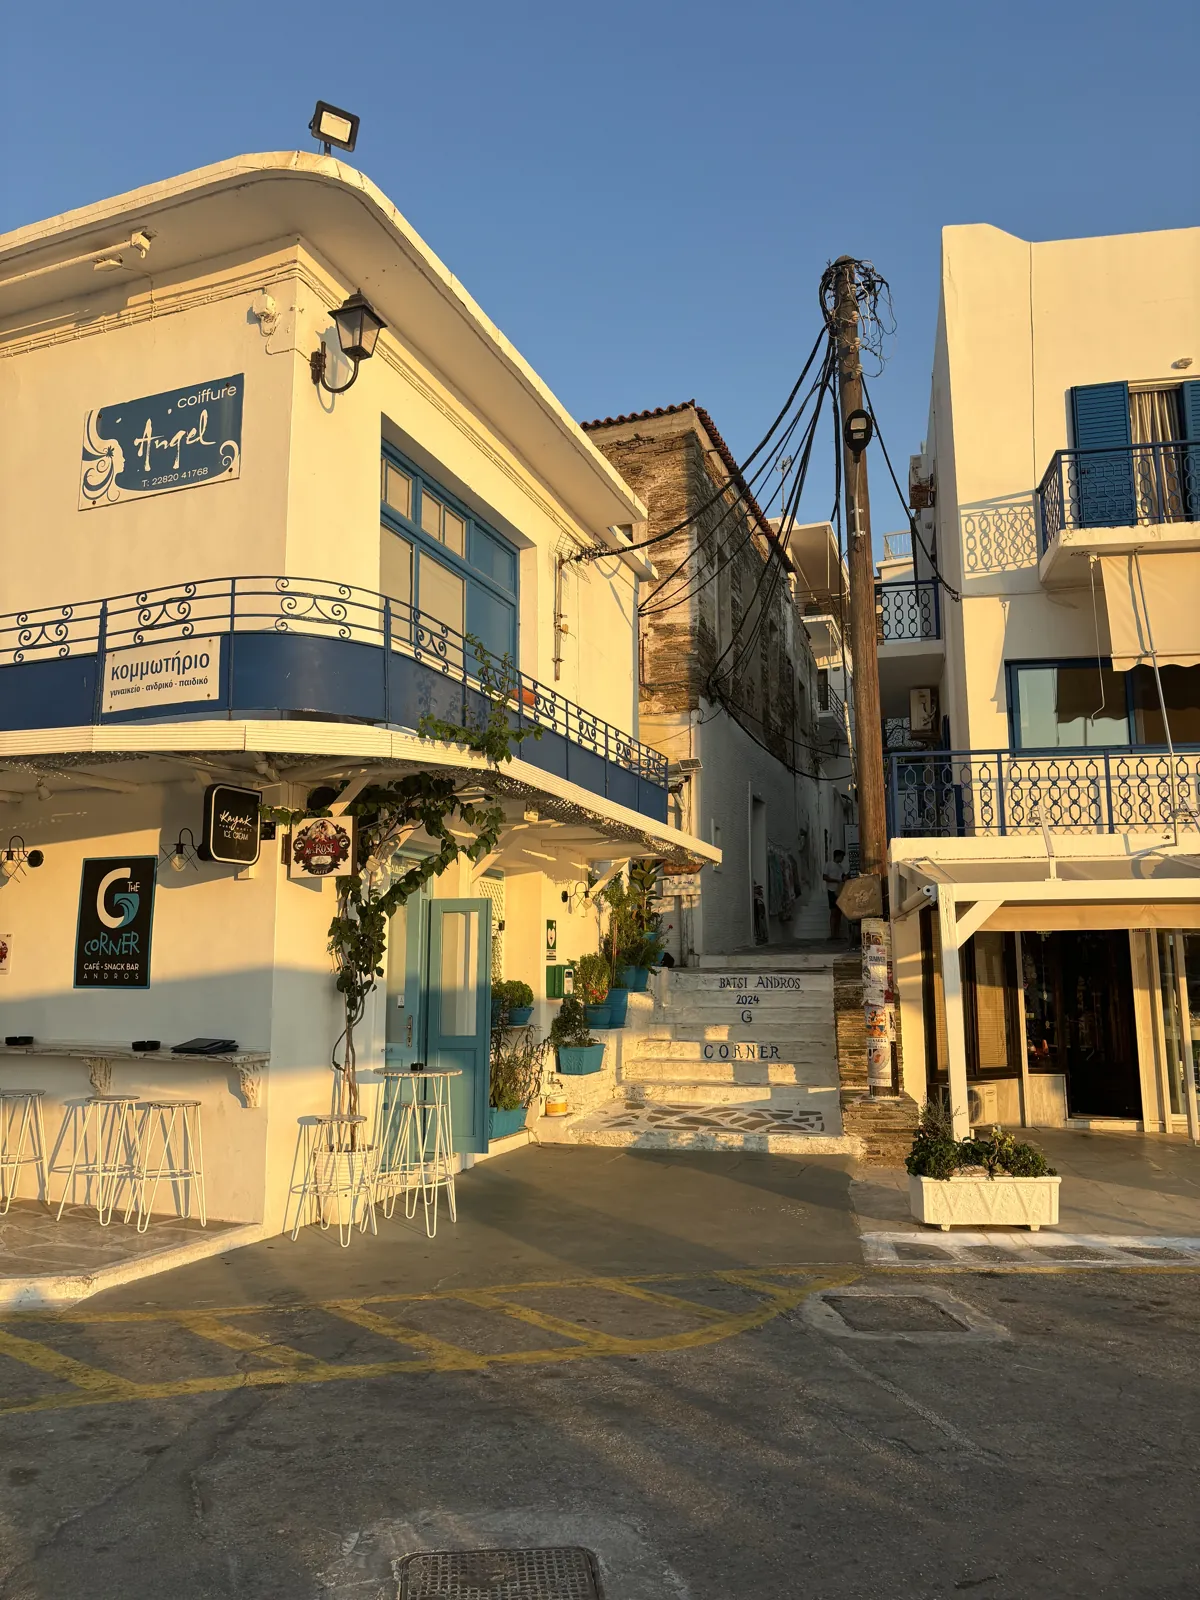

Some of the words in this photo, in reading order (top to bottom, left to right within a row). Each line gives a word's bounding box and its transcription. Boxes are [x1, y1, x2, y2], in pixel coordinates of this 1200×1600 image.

[177, 385, 237, 408] coiffure
[133, 409, 216, 472] Angel
[152, 474, 179, 486] 22820
[181, 467, 209, 479] 41768
[111, 650, 210, 682] κομμωτήριο
[110, 684, 141, 698] γυναικείο
[145, 679, 173, 692] ανδρικό
[179, 676, 209, 687] παιδικό
[219, 810, 252, 831] Kayak
[223, 830, 231, 838] ICE
[232, 831, 249, 841] CREAM
[127, 881, 140, 892] THE
[84, 931, 140, 956] CORNER
[83, 961, 100, 971] CAFÉ
[104, 963, 125, 971] SNACK
[126, 963, 140, 971] BAR
[719, 977, 748, 989] BATSI
[754, 976, 801, 989] ANDROS
[736, 995, 760, 1005] 2024
[704, 1044, 781, 1059] CORNER
